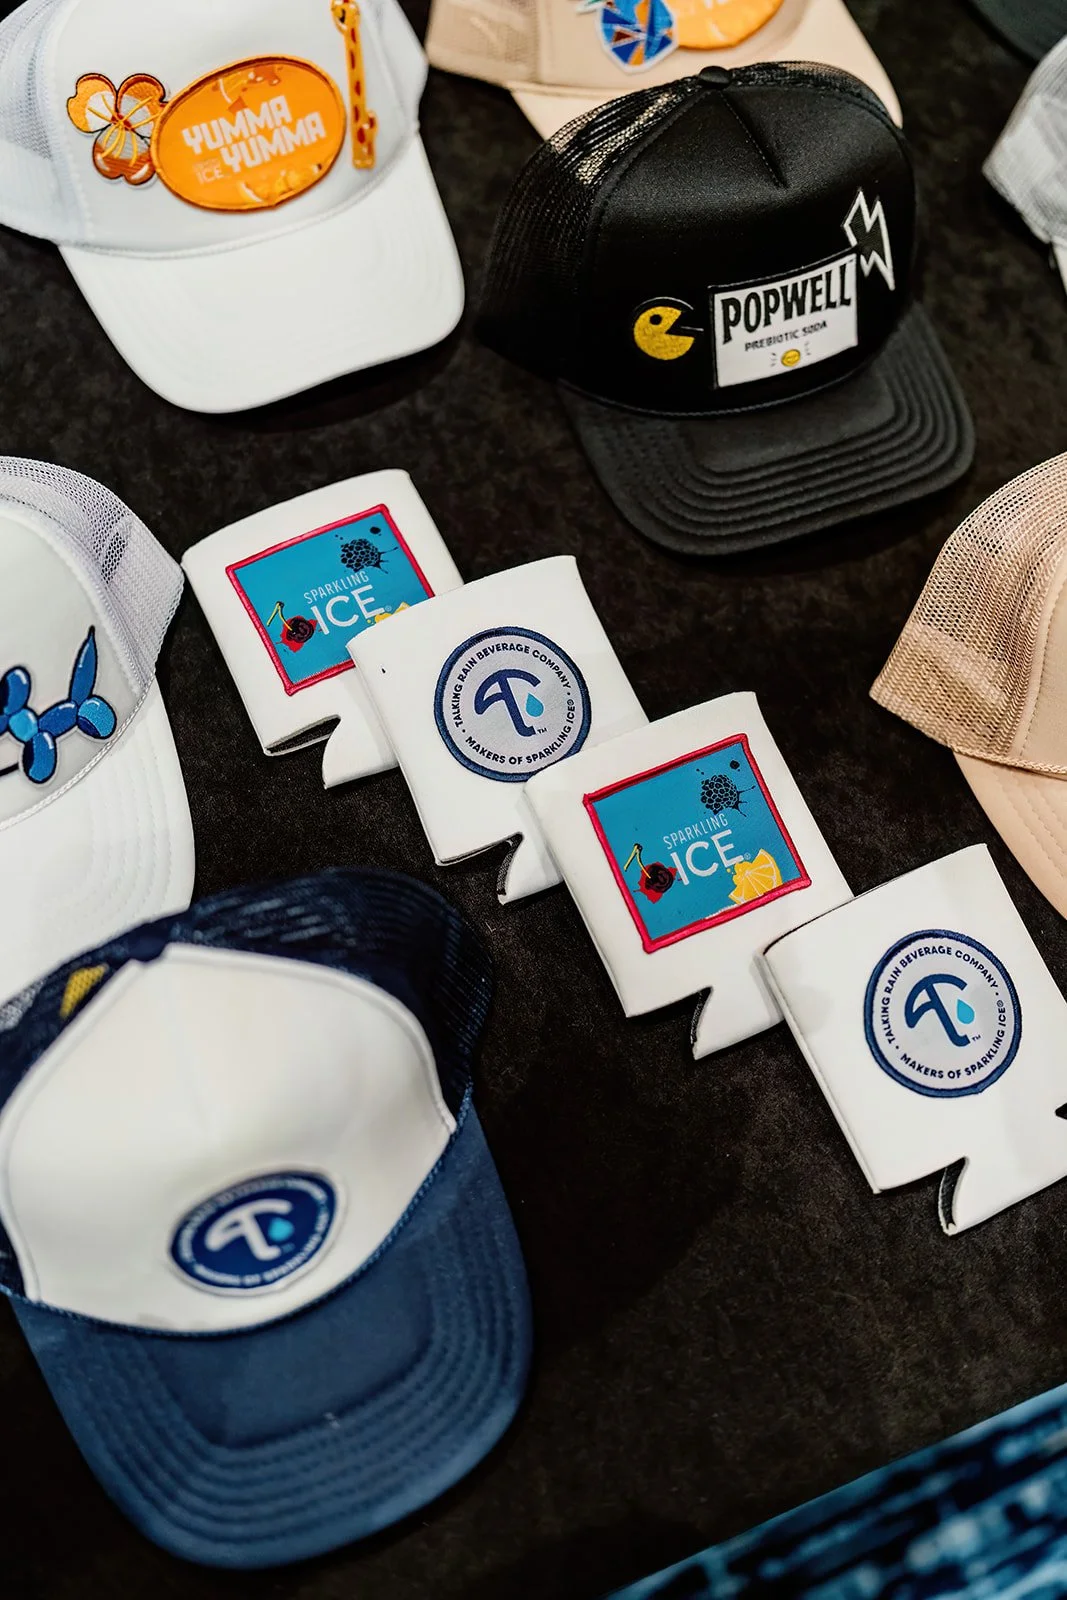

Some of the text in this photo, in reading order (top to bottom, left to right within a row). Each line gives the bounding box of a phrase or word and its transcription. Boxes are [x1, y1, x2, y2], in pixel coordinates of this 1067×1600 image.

[182, 95, 292, 155] YUMMA
[220, 112, 326, 173] YUMMA
[720, 263, 852, 345] POPWELL
[744, 320, 828, 352] PREBIOTIC SODA
[303, 570, 370, 605] SPARKLING
[451, 642, 571, 728] TALKING RAIN BEVERAGE COMPANY
[465, 735, 506, 764] MAKERS
[508, 756, 523, 765] OF
[526, 725, 571, 764] SPARKLING
[662, 813, 729, 850] SPARKLING
[880, 945, 999, 1045] TALKING RAIN BEVERAGE COMPANY
[900, 1053, 944, 1079] MAKERS
[947, 1069, 962, 1079] OF
[964, 1030, 1006, 1076] SPARKLING
